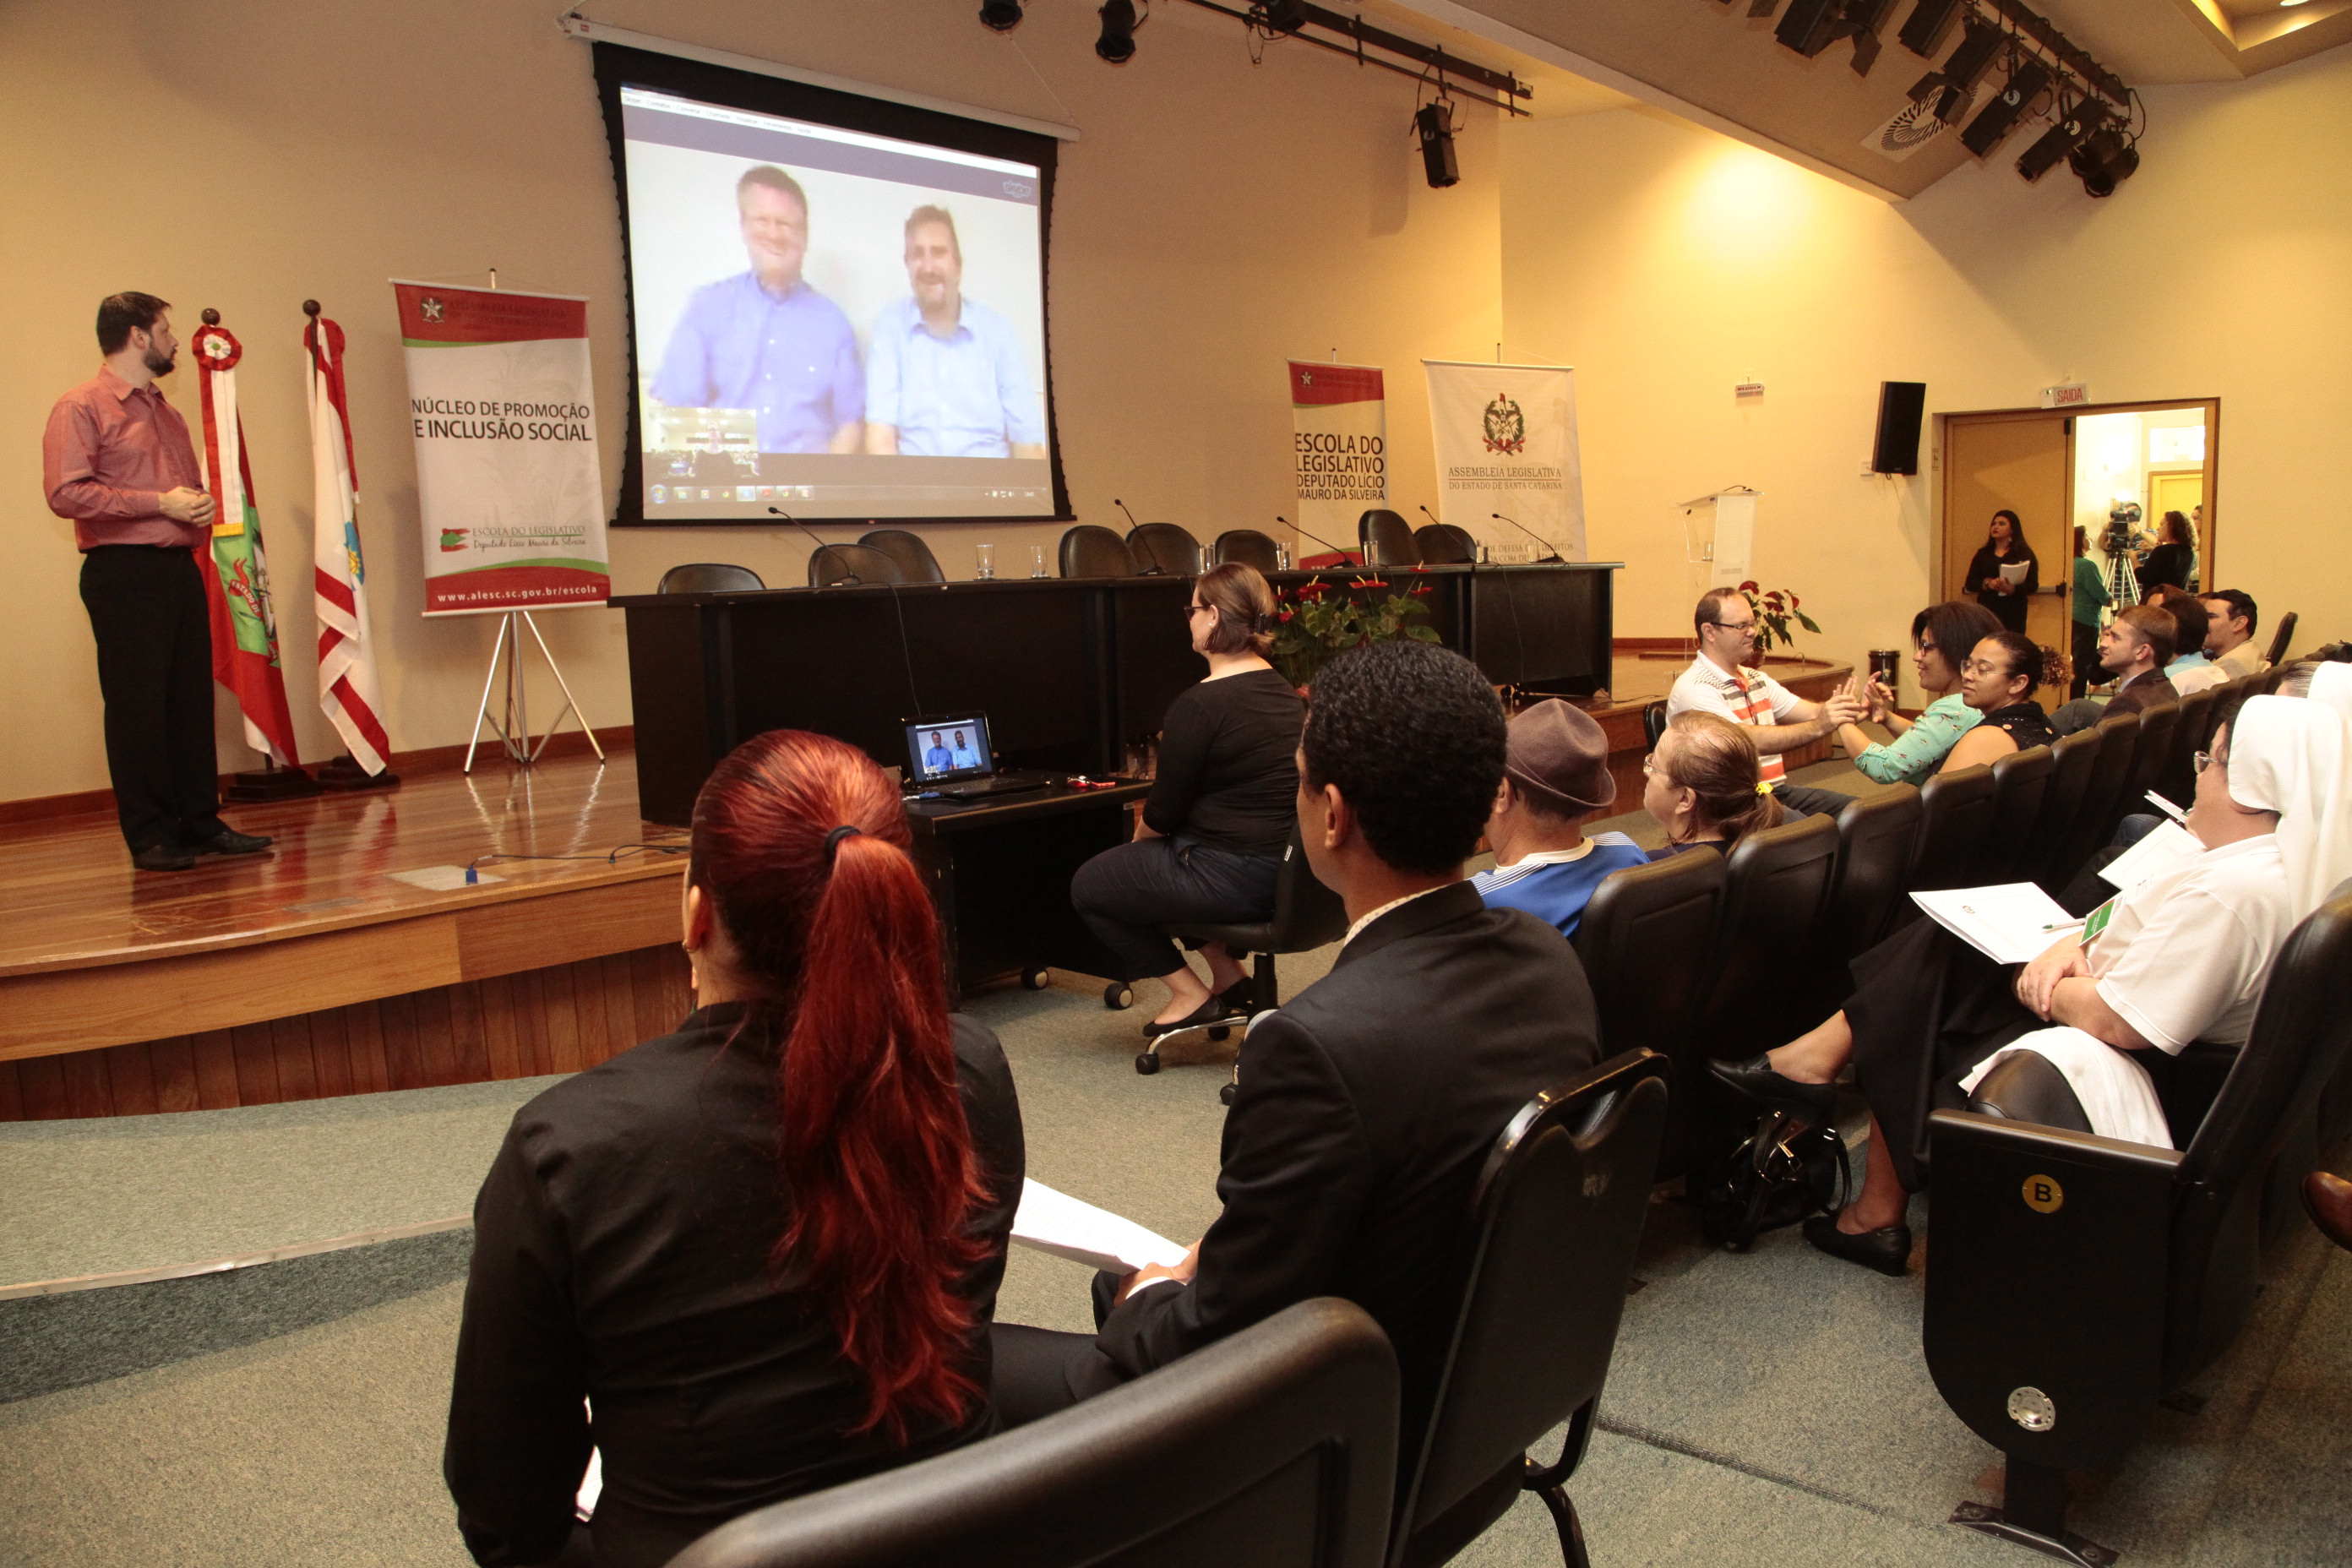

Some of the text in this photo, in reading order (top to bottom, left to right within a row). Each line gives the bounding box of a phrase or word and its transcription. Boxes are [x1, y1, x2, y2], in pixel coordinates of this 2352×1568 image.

[412, 397, 590, 422] NÚCLEO DE PROMOÇÃO
[415, 417, 593, 441] E INCLUSÃO SOCIAL
[1295, 433, 1384, 455] ESCOLA DO
[1296, 455, 1385, 474] LEGISLATIVO
[1449, 466, 1561, 477] ASSEMBLEIA LEGISLATIVA
[1298, 472, 1385, 488] DEPUTADO LÍCIO
[1504, 482, 1527, 490] SANTA
[1528, 482, 1562, 490] CATARINA
[1298, 488, 1386, 501] MAURO DA SILVEIRA
[472, 525, 585, 536] ESCOLA DO LEGISLATIVO
[474, 539, 507, 553] Deputado
[561, 536, 585, 546] Silveira
[1498, 545, 1523, 553] DEFESA
[1500, 554, 1516, 563] COM
[231, 580, 255, 603] ESTADO
[438, 585, 597, 602] www.alesc.sc.gov.br/escola
[2035, 1183, 2052, 1203] B
